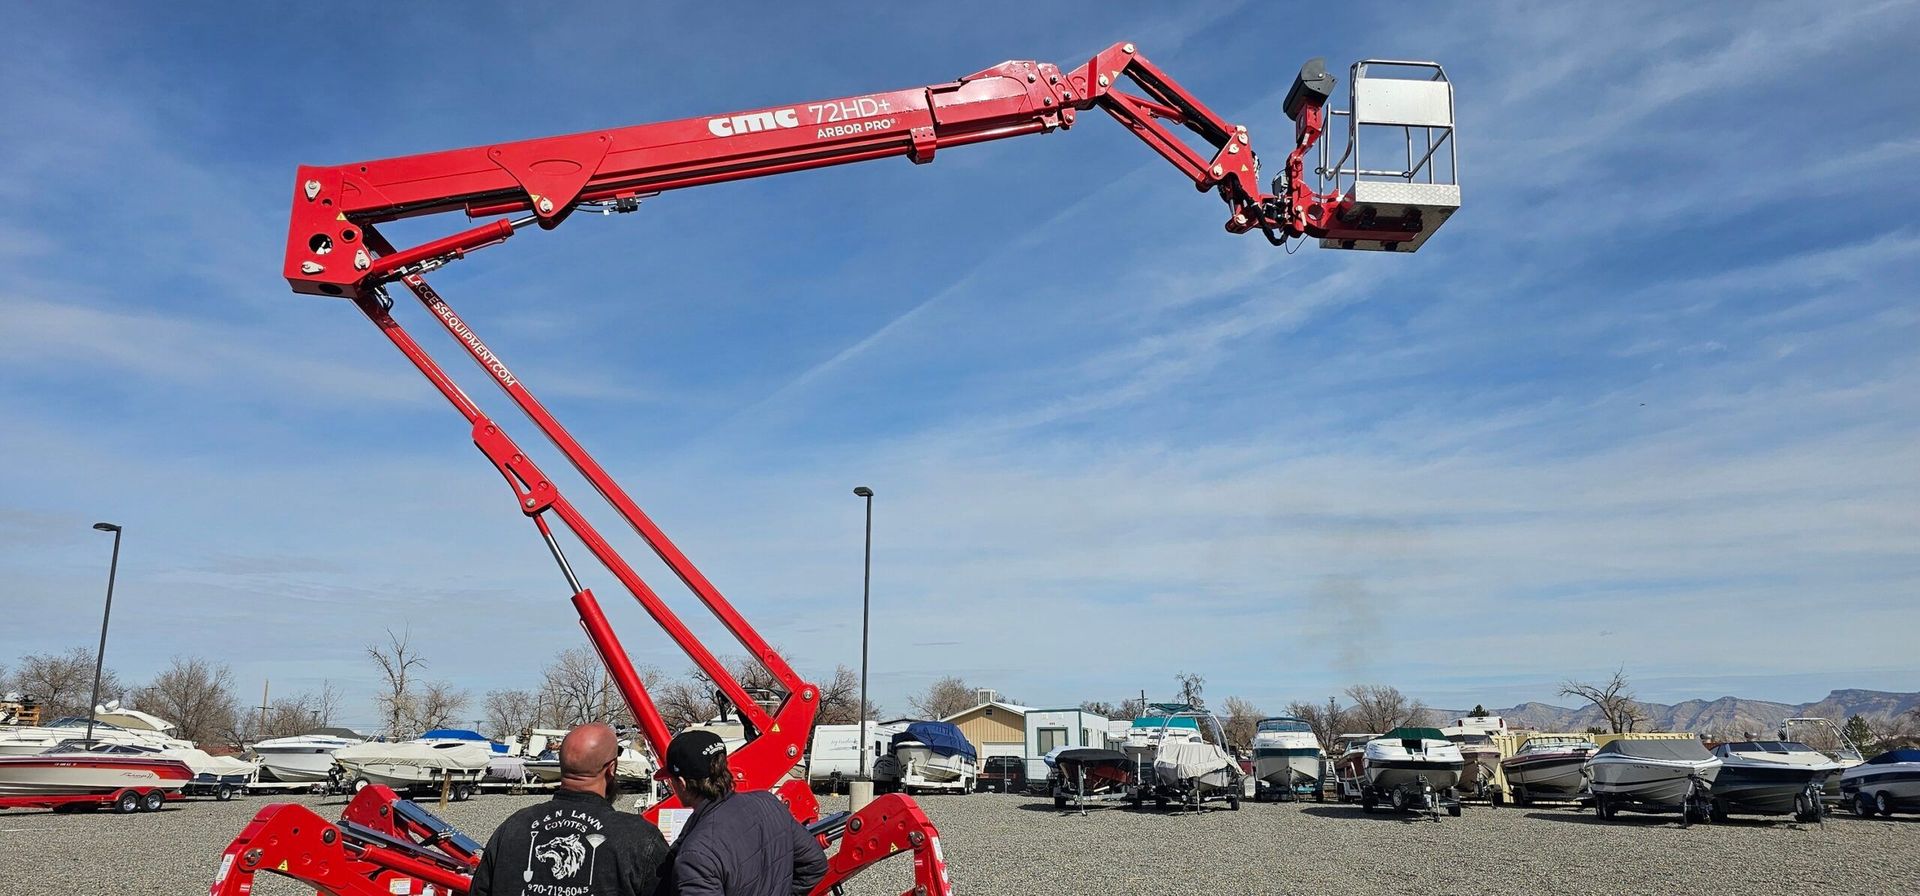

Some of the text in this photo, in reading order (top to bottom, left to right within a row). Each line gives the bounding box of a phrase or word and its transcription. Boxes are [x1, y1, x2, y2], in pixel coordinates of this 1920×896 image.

[808, 99, 890, 123] 72HD+
[817, 122, 862, 139] ARBOR
[405, 274, 515, 387] LACCESSEQUIPMENT.COM
[544, 819, 588, 833] COYOTES
[555, 810, 563, 818] N
[571, 810, 603, 831] LAWN
[527, 884, 589, 896] 970-712-6045
